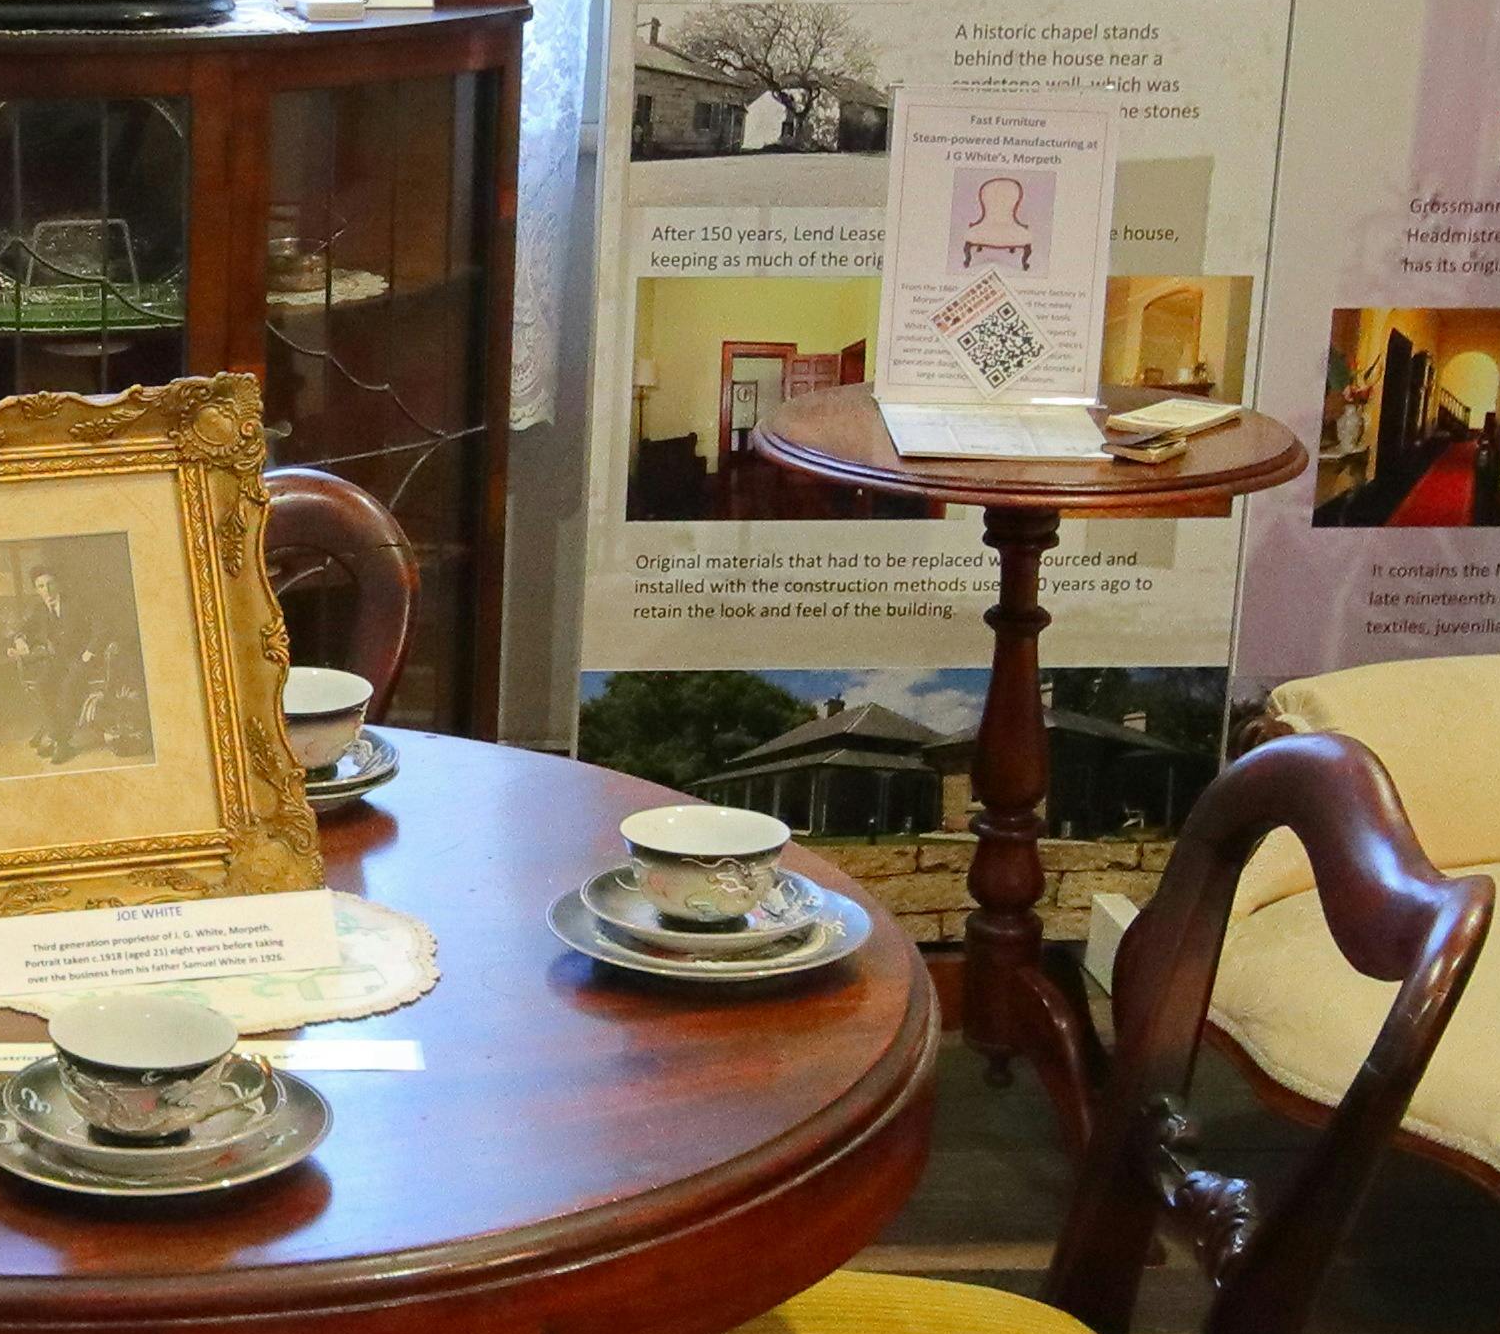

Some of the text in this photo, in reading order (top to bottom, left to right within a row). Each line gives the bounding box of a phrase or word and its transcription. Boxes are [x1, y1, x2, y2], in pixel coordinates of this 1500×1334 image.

[970, 114, 1046, 127] Fast Furniture
[913, 132, 1097, 150] Steam-powered Manufacturing at
[945, 151, 1061, 165] J G White's, Morpeth
[1366, 619, 1430, 635] textiles,
[116, 906, 182, 922] JOE WHITE
[32, 923, 273, 952] Third generation proprietor of J. G. White, Morpeth.
[25, 958, 60, 968] Portrait
[63, 954, 89, 964] taken
[125, 949, 150, 960] (aged
[170, 946, 193, 955] eight
[196, 945, 220, 953] years
[222, 941, 253, 952] before
[255, 938, 284, 950] taking
[27, 953, 284, 984] over the business from his father Samuel White in 1926.
